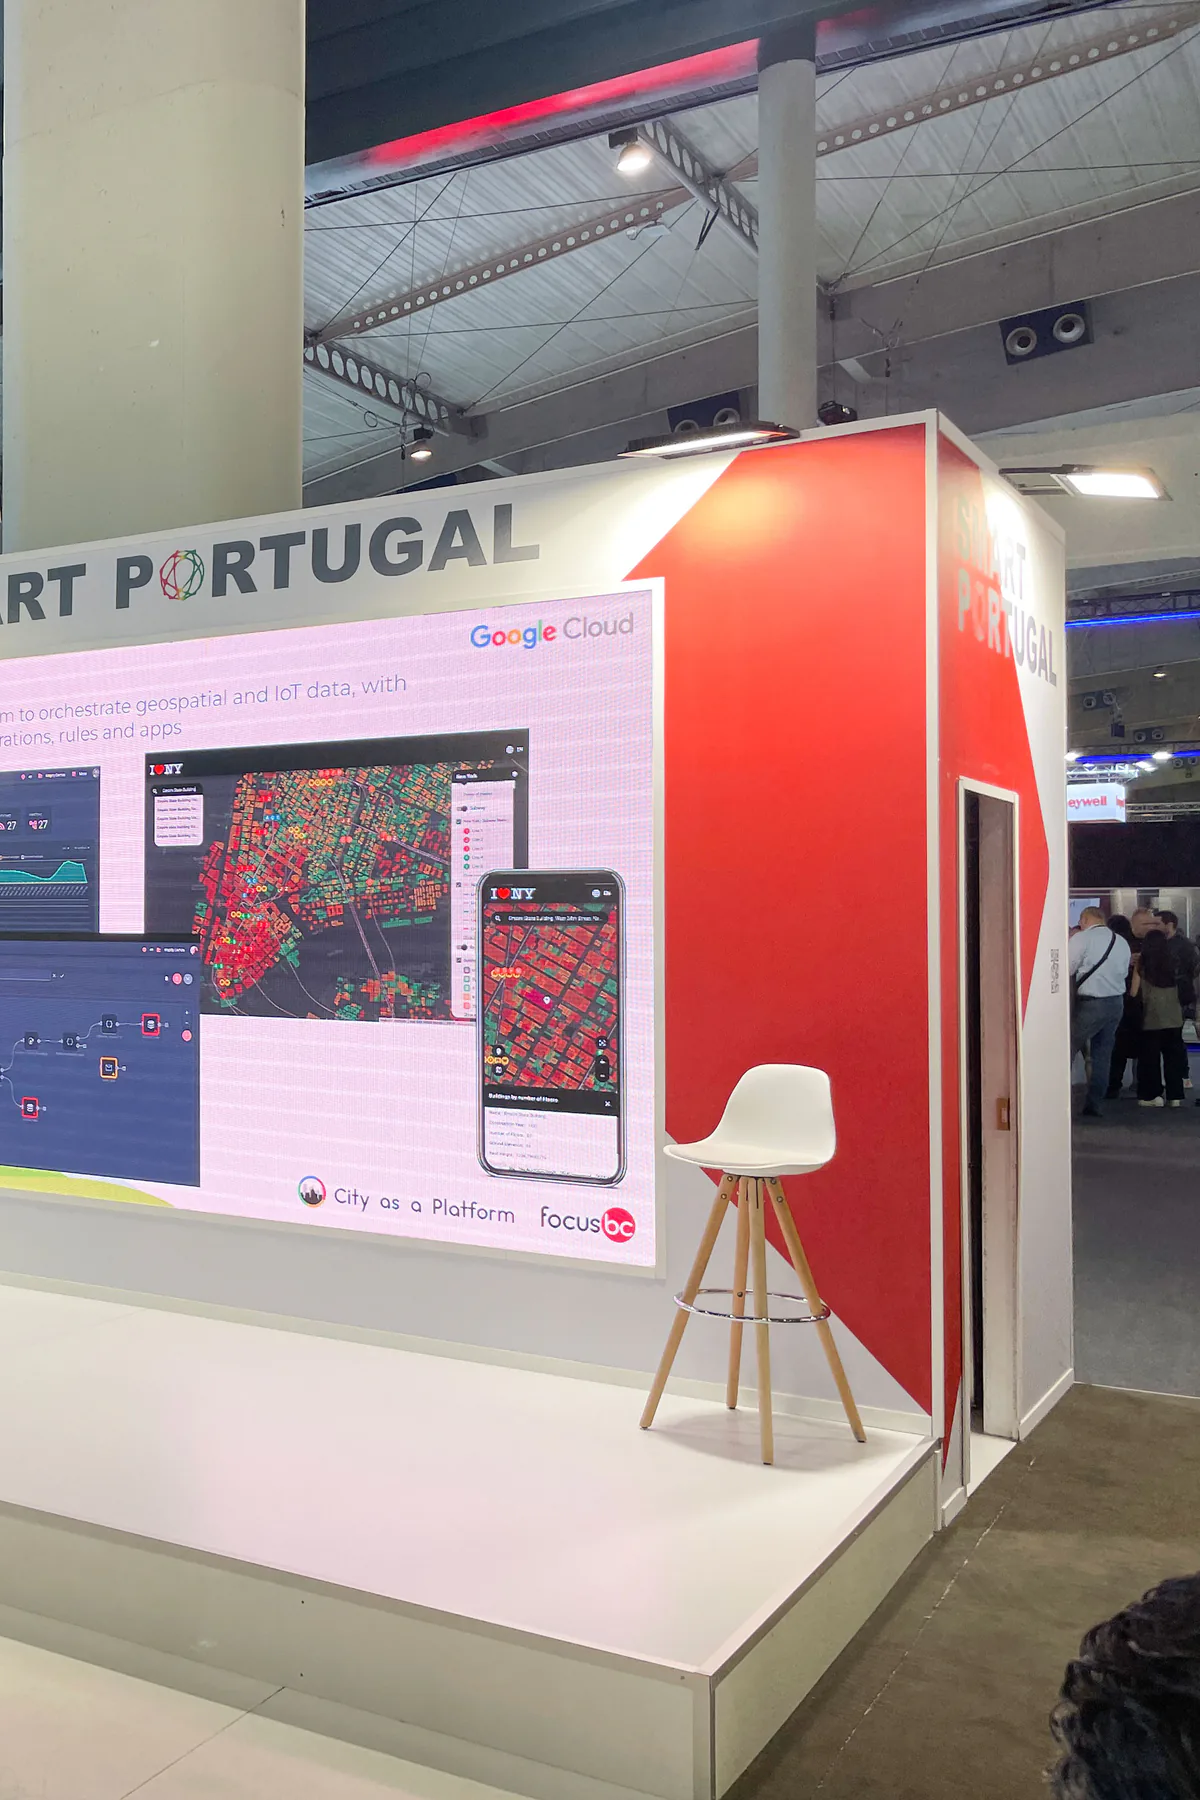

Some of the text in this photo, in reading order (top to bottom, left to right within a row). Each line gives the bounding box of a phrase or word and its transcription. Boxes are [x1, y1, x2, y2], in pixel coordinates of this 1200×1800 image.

[115, 503, 540, 610] PORTUGAL
[470, 612, 634, 649] Google Cloud
[19, 707, 35, 721] to
[39, 700, 132, 720] orchestrate
[136, 689, 227, 716] geospatial
[233, 686, 268, 704] and
[275, 683, 302, 702] IoT
[307, 681, 356, 698] data,
[361, 674, 407, 694] with
[59, 726, 98, 743] rules
[103, 722, 135, 740] and
[140, 722, 182, 740] apps
[7, 820, 17, 831] 27
[38, 819, 48, 830] 27
[334, 1188, 515, 1223] City as a Platform
